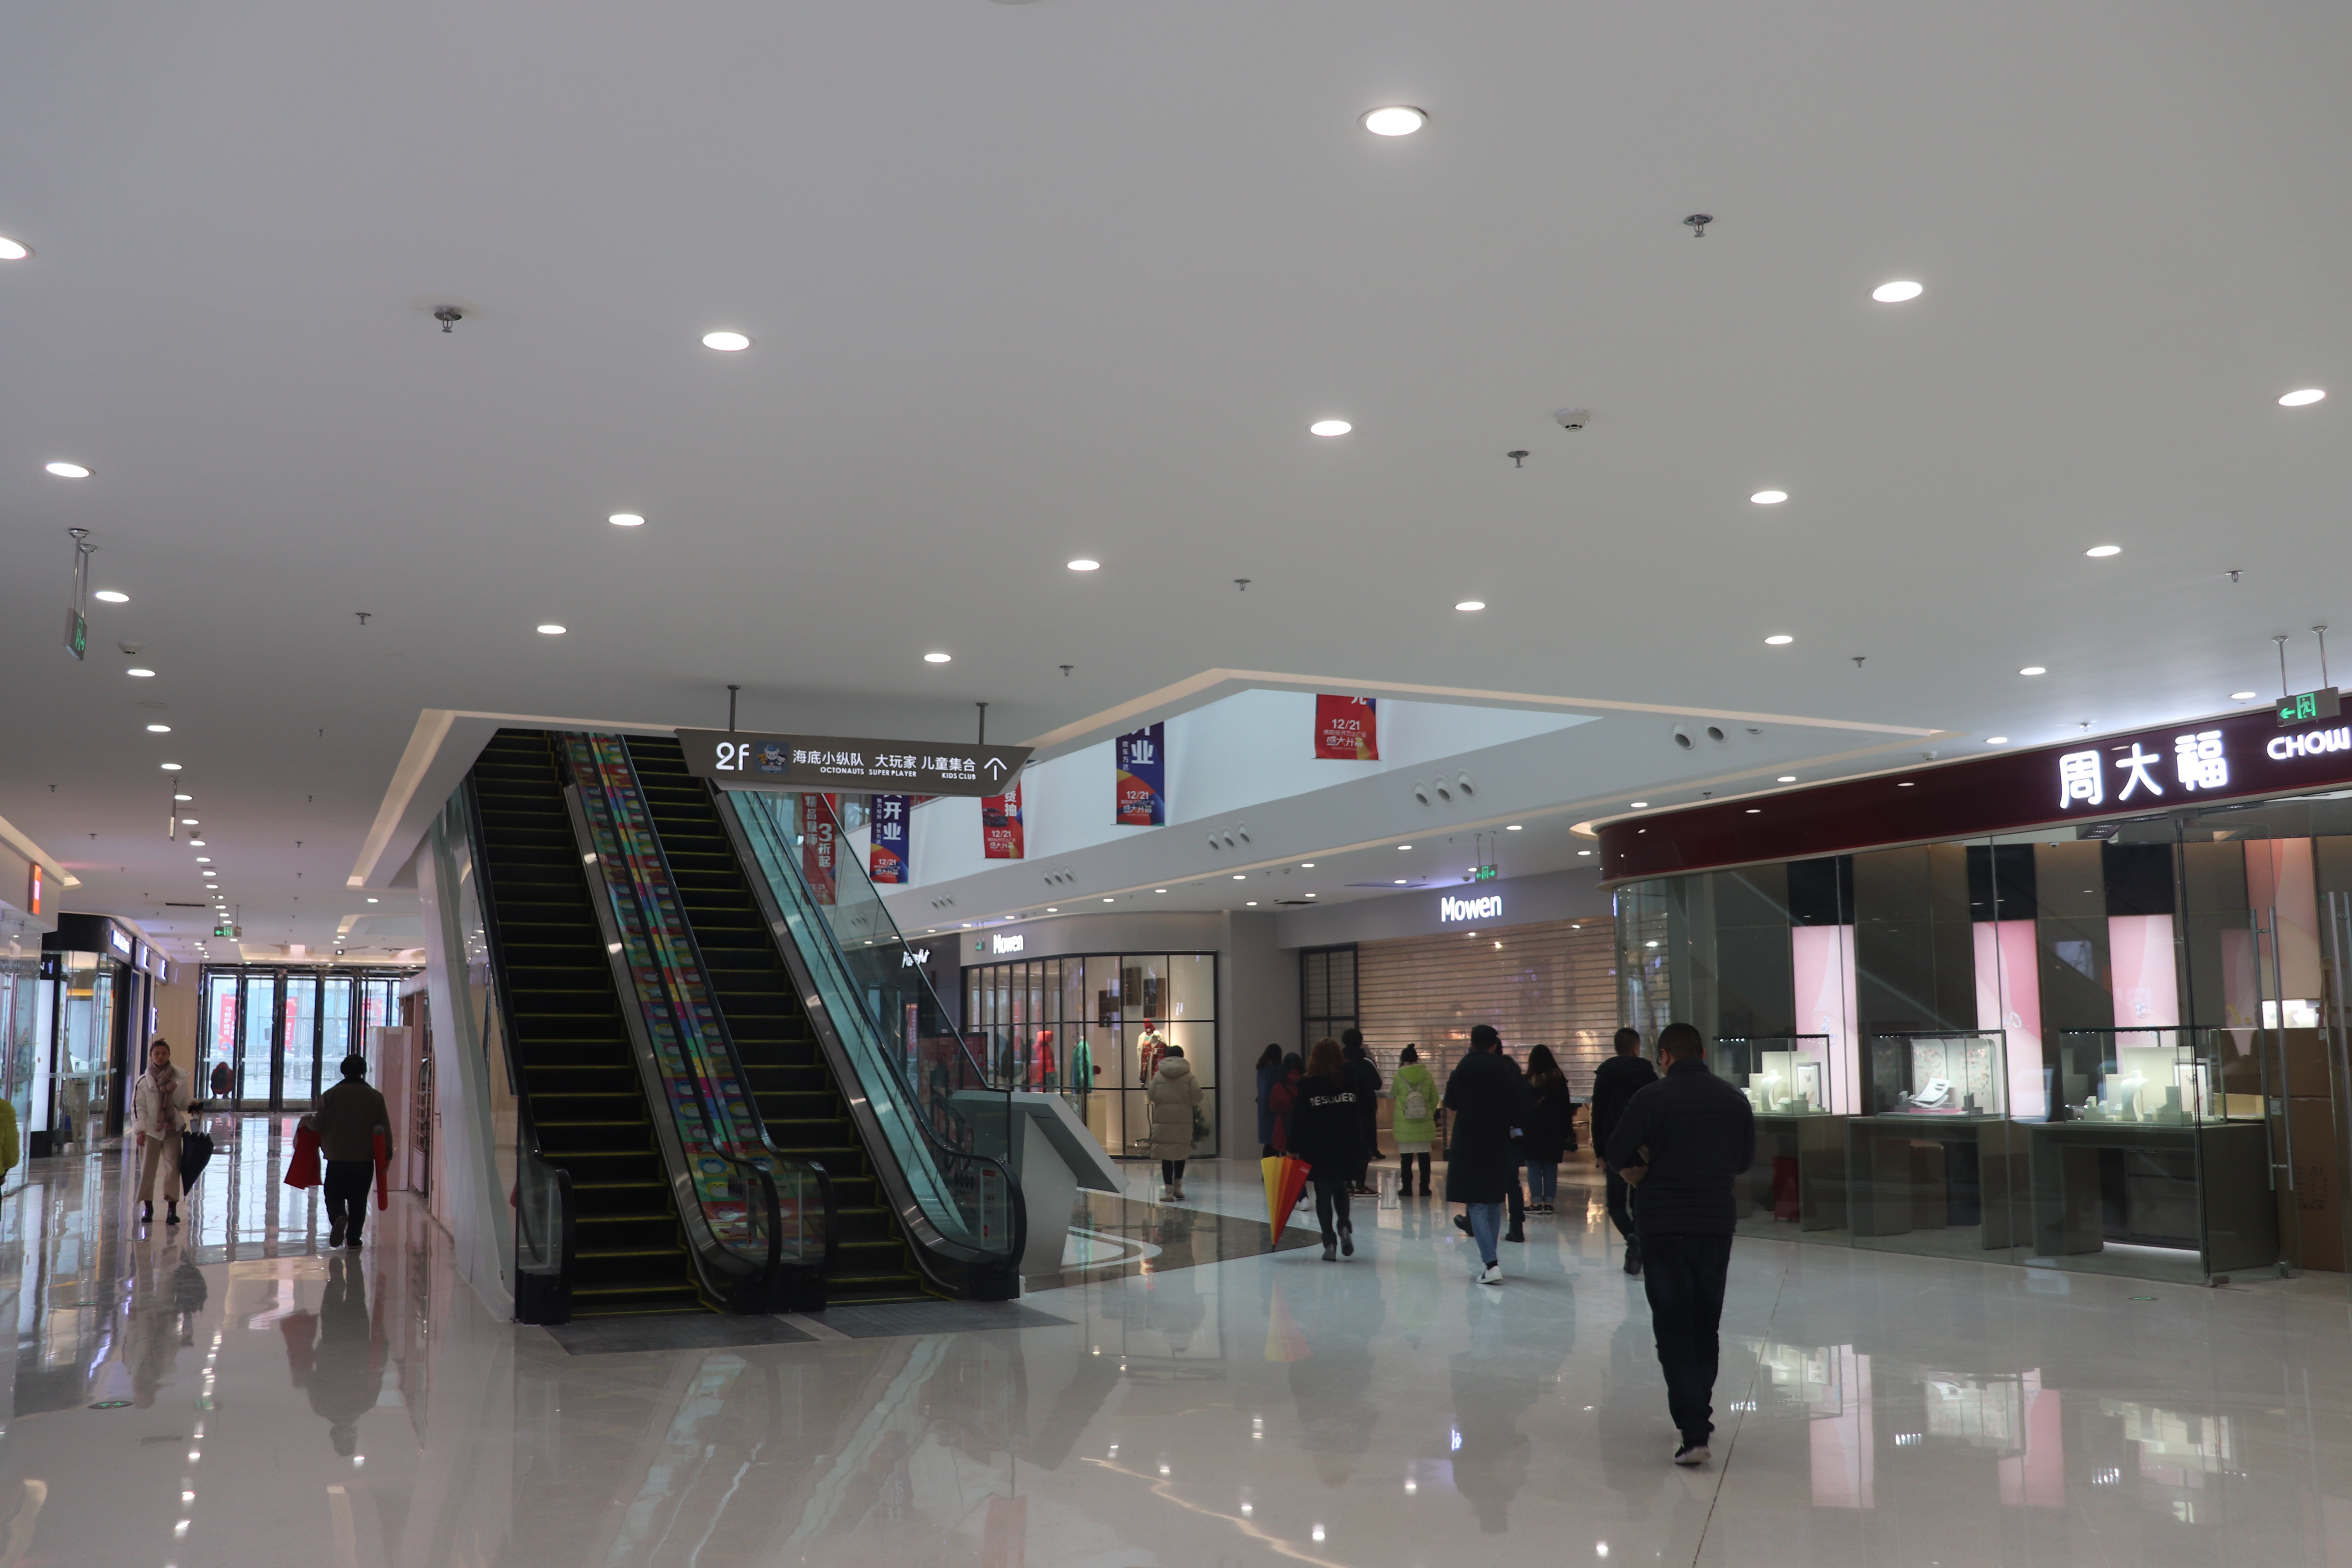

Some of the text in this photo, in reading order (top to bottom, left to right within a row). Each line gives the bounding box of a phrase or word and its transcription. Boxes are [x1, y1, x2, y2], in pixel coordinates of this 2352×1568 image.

[1332, 719, 1360, 730] 12/21
[2267, 726, 2350, 760] CHOW
[793, 749, 976, 772] 海底小纵队 大玩家 儿童集合
[820, 767, 865, 775] OCTONAUTS
[2059, 730, 2229, 809] 周大福
[1126, 791, 1149, 799] 12/21
[883, 795, 902, 840] 开业
[1441, 896, 1503, 922] Mowen
[993, 934, 1024, 954] Mowen
